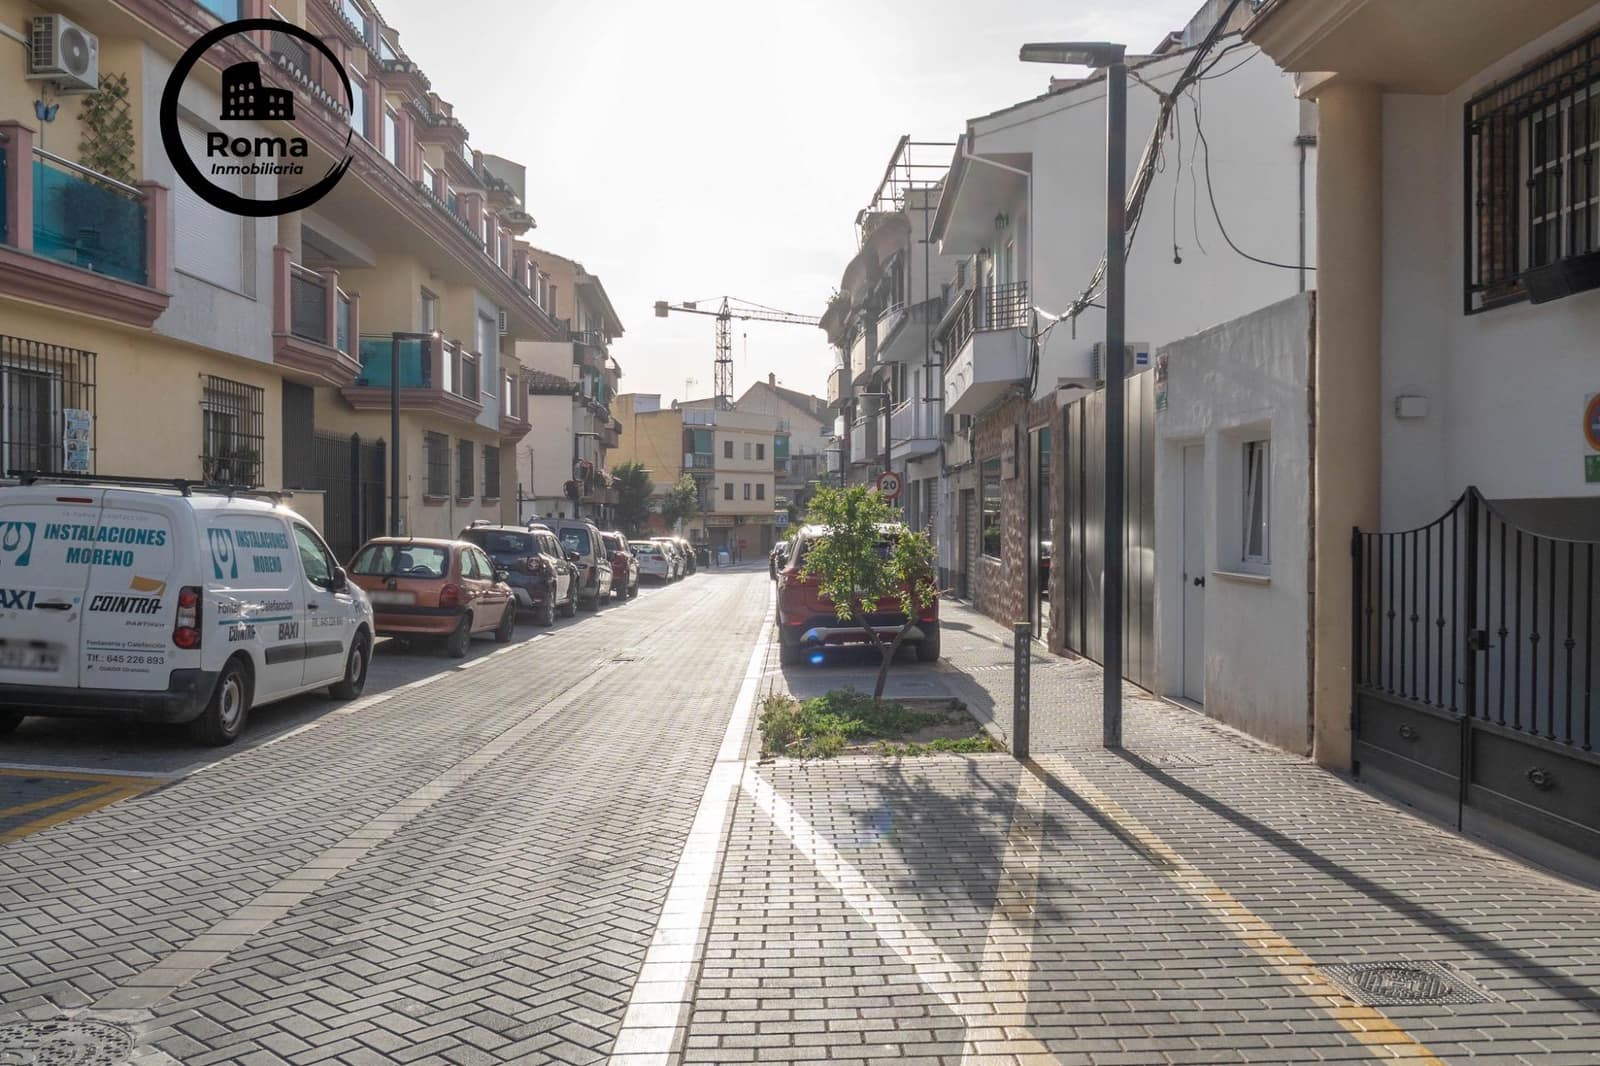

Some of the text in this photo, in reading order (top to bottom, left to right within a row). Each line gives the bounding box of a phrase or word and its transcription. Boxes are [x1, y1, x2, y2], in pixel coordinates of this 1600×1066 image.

[883, 480, 896, 490] 20
[43, 523, 166, 546] INSTALACIONES
[236, 531, 288, 548] INSTALACIONES
[66, 547, 134, 567] MORENO
[253, 556, 281, 572] MORENO
[89, 594, 162, 614] COINTRA
[278, 622, 299, 640] BAXI
[106, 654, 124, 663] 645
[126, 655, 144, 664] 226
[146, 656, 164, 665] 893
